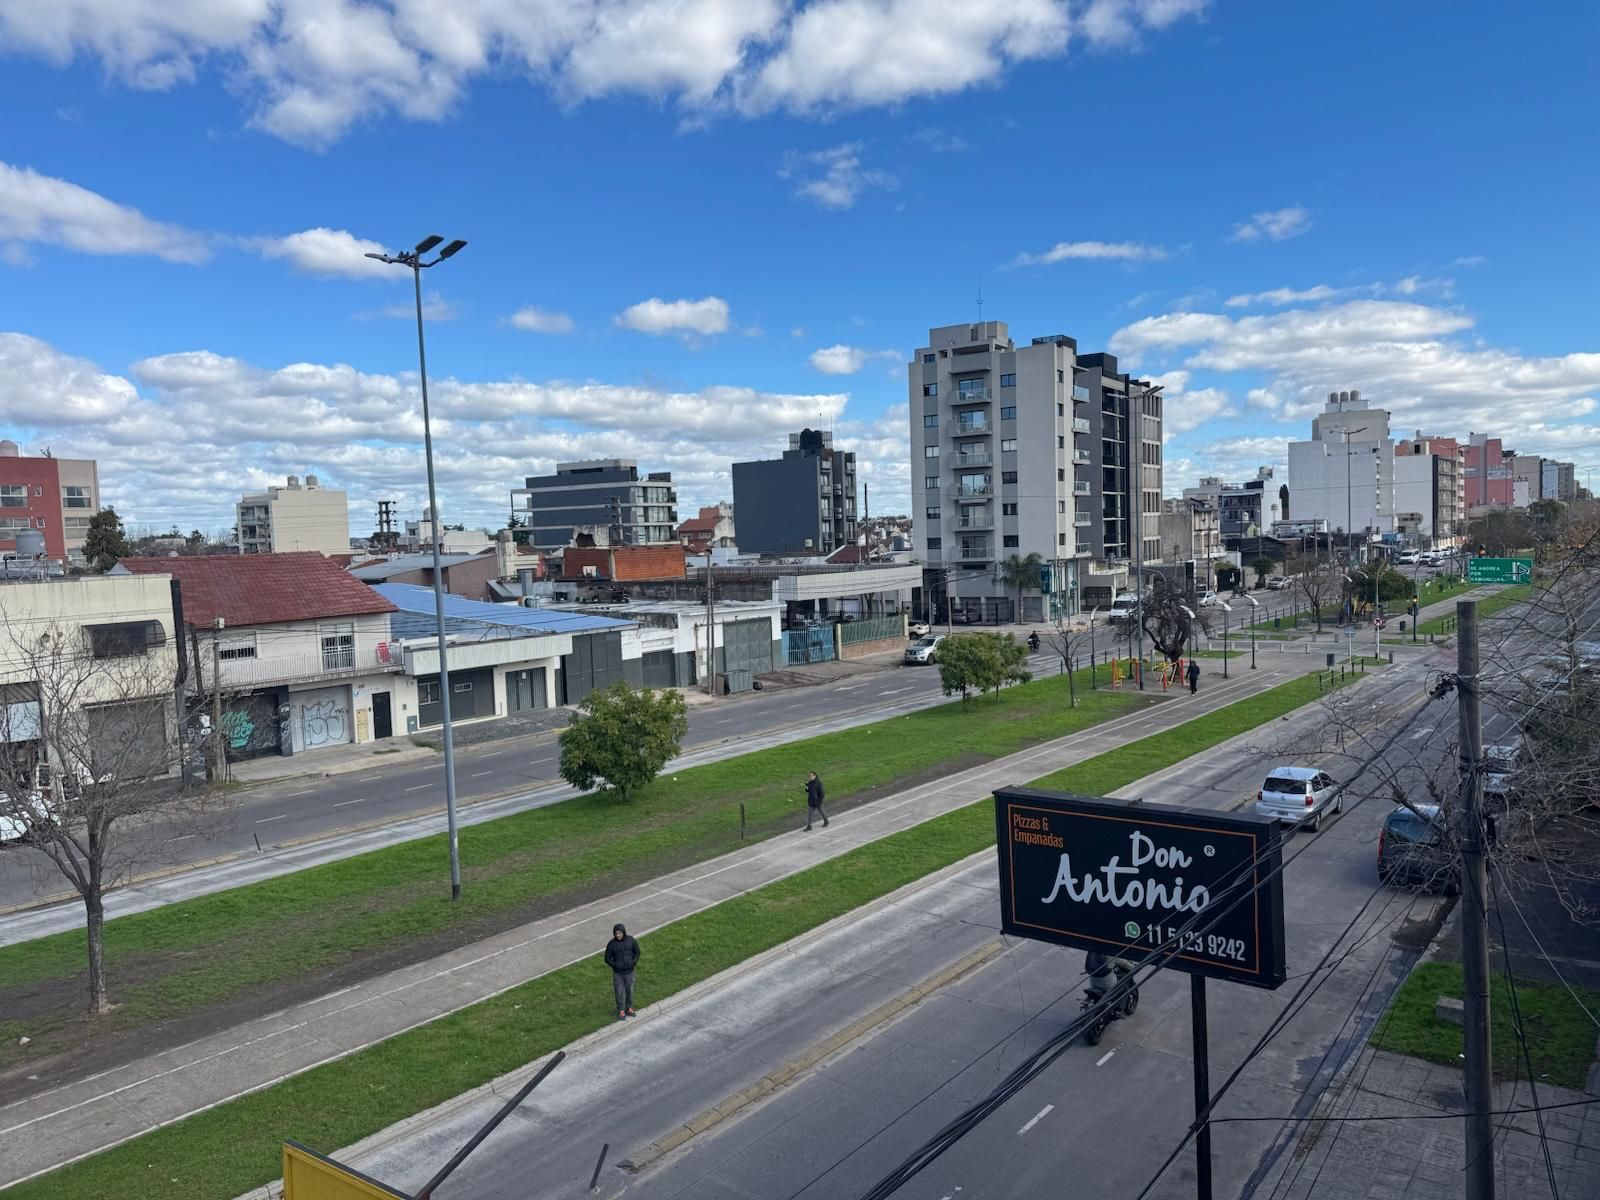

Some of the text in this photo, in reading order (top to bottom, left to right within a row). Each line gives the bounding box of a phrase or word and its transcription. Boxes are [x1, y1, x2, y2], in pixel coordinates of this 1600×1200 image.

[1013, 814, 1049, 831] Pizzas &
[1014, 829, 1064, 848] Empanadas
[1129, 830, 1192, 869] Don
[1041, 853, 1210, 913] Antonio
[1147, 923, 1161, 944] 11
[1207, 934, 1246, 961] 9242
